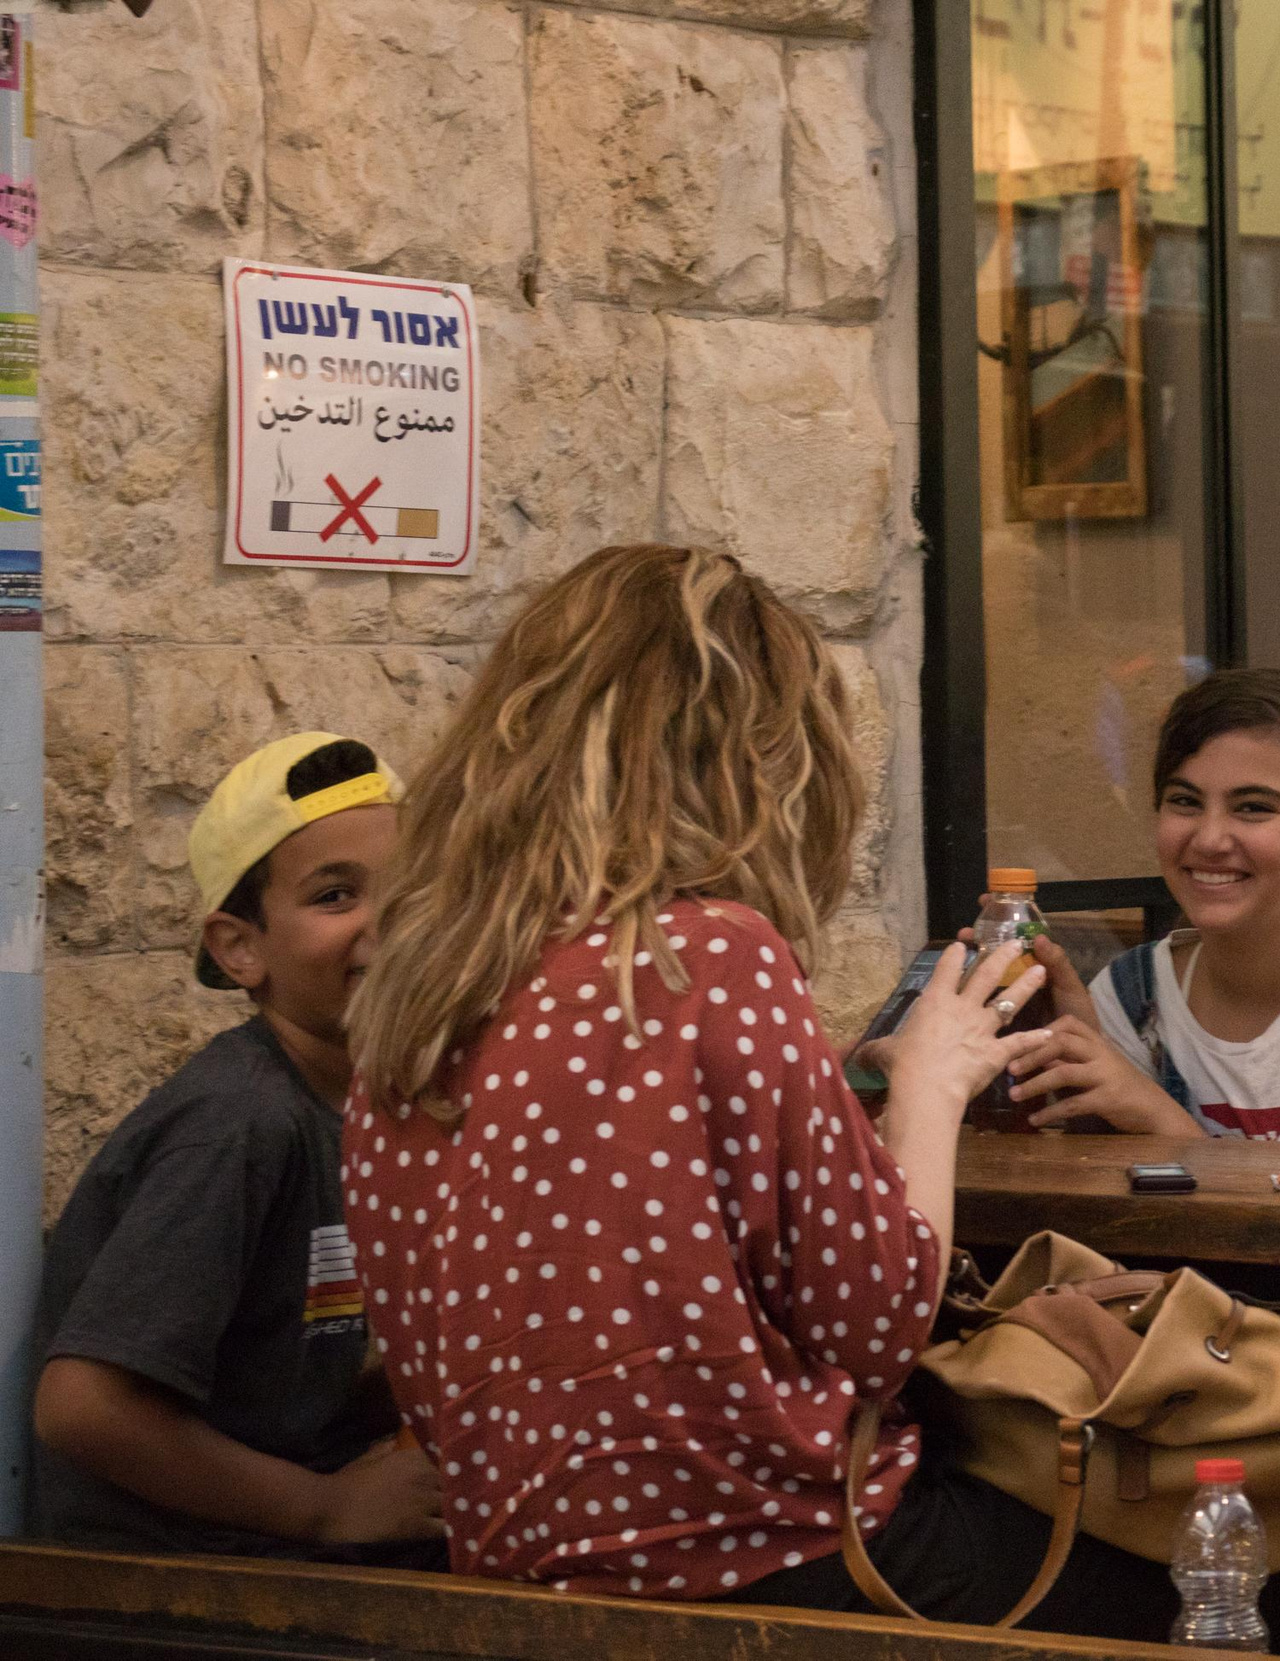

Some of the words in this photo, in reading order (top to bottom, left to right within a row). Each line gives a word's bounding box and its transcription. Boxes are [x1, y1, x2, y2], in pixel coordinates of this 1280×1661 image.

[258, 296, 360, 340] לעשן
[371, 309, 461, 349] אסור
[263, 351, 308, 381] NO
[319, 356, 461, 393] SMOKING
[257, 395, 363, 434] التدخين
[373, 405, 455, 443] ممنوع
